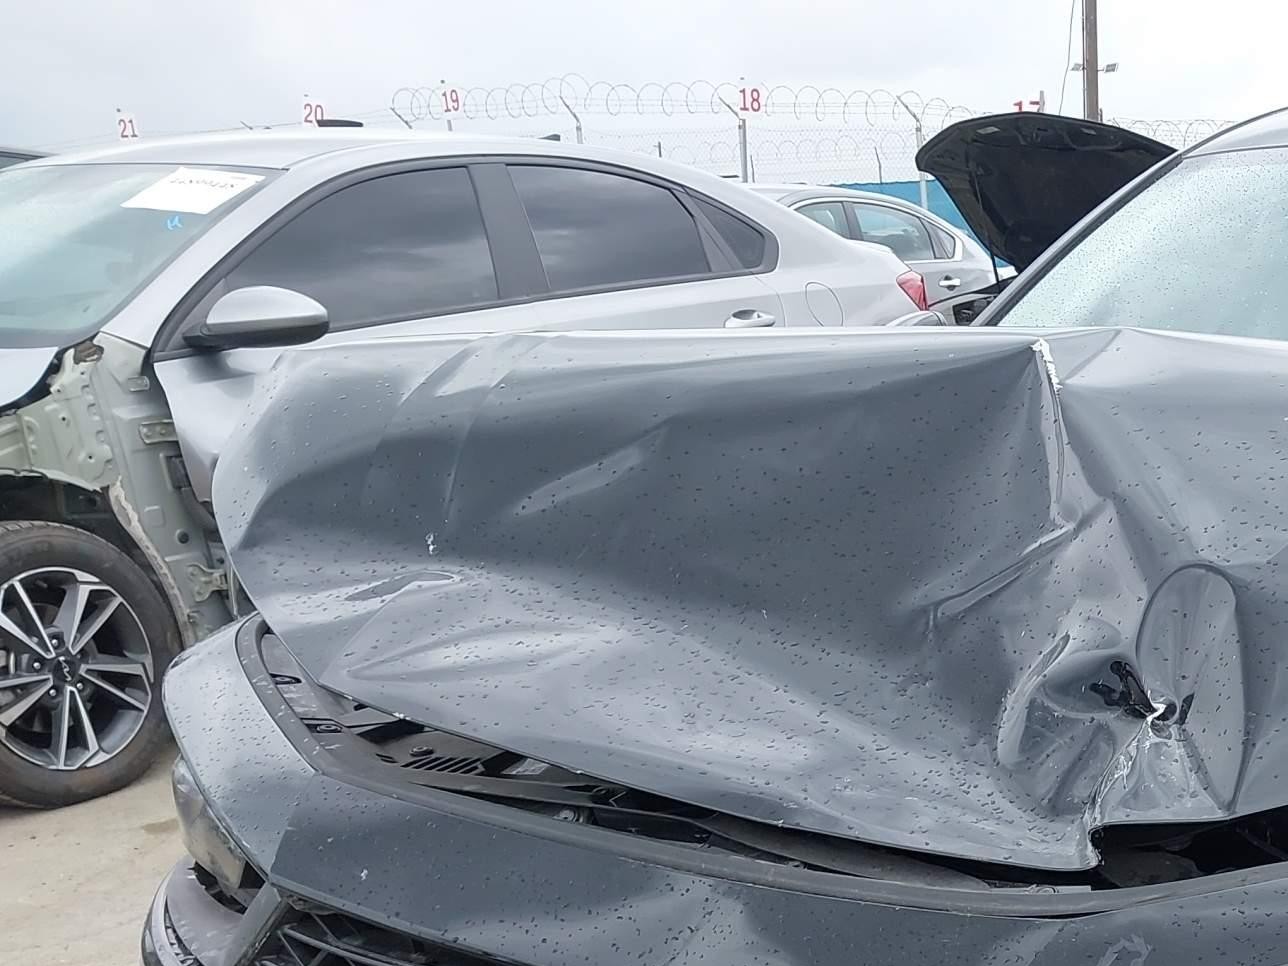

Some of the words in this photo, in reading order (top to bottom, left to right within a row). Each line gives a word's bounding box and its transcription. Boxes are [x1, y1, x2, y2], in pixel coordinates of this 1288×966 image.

[441, 88, 462, 113] 19
[738, 87, 762, 113] 18
[302, 103, 325, 125] 20
[117, 118, 138, 139] 21
